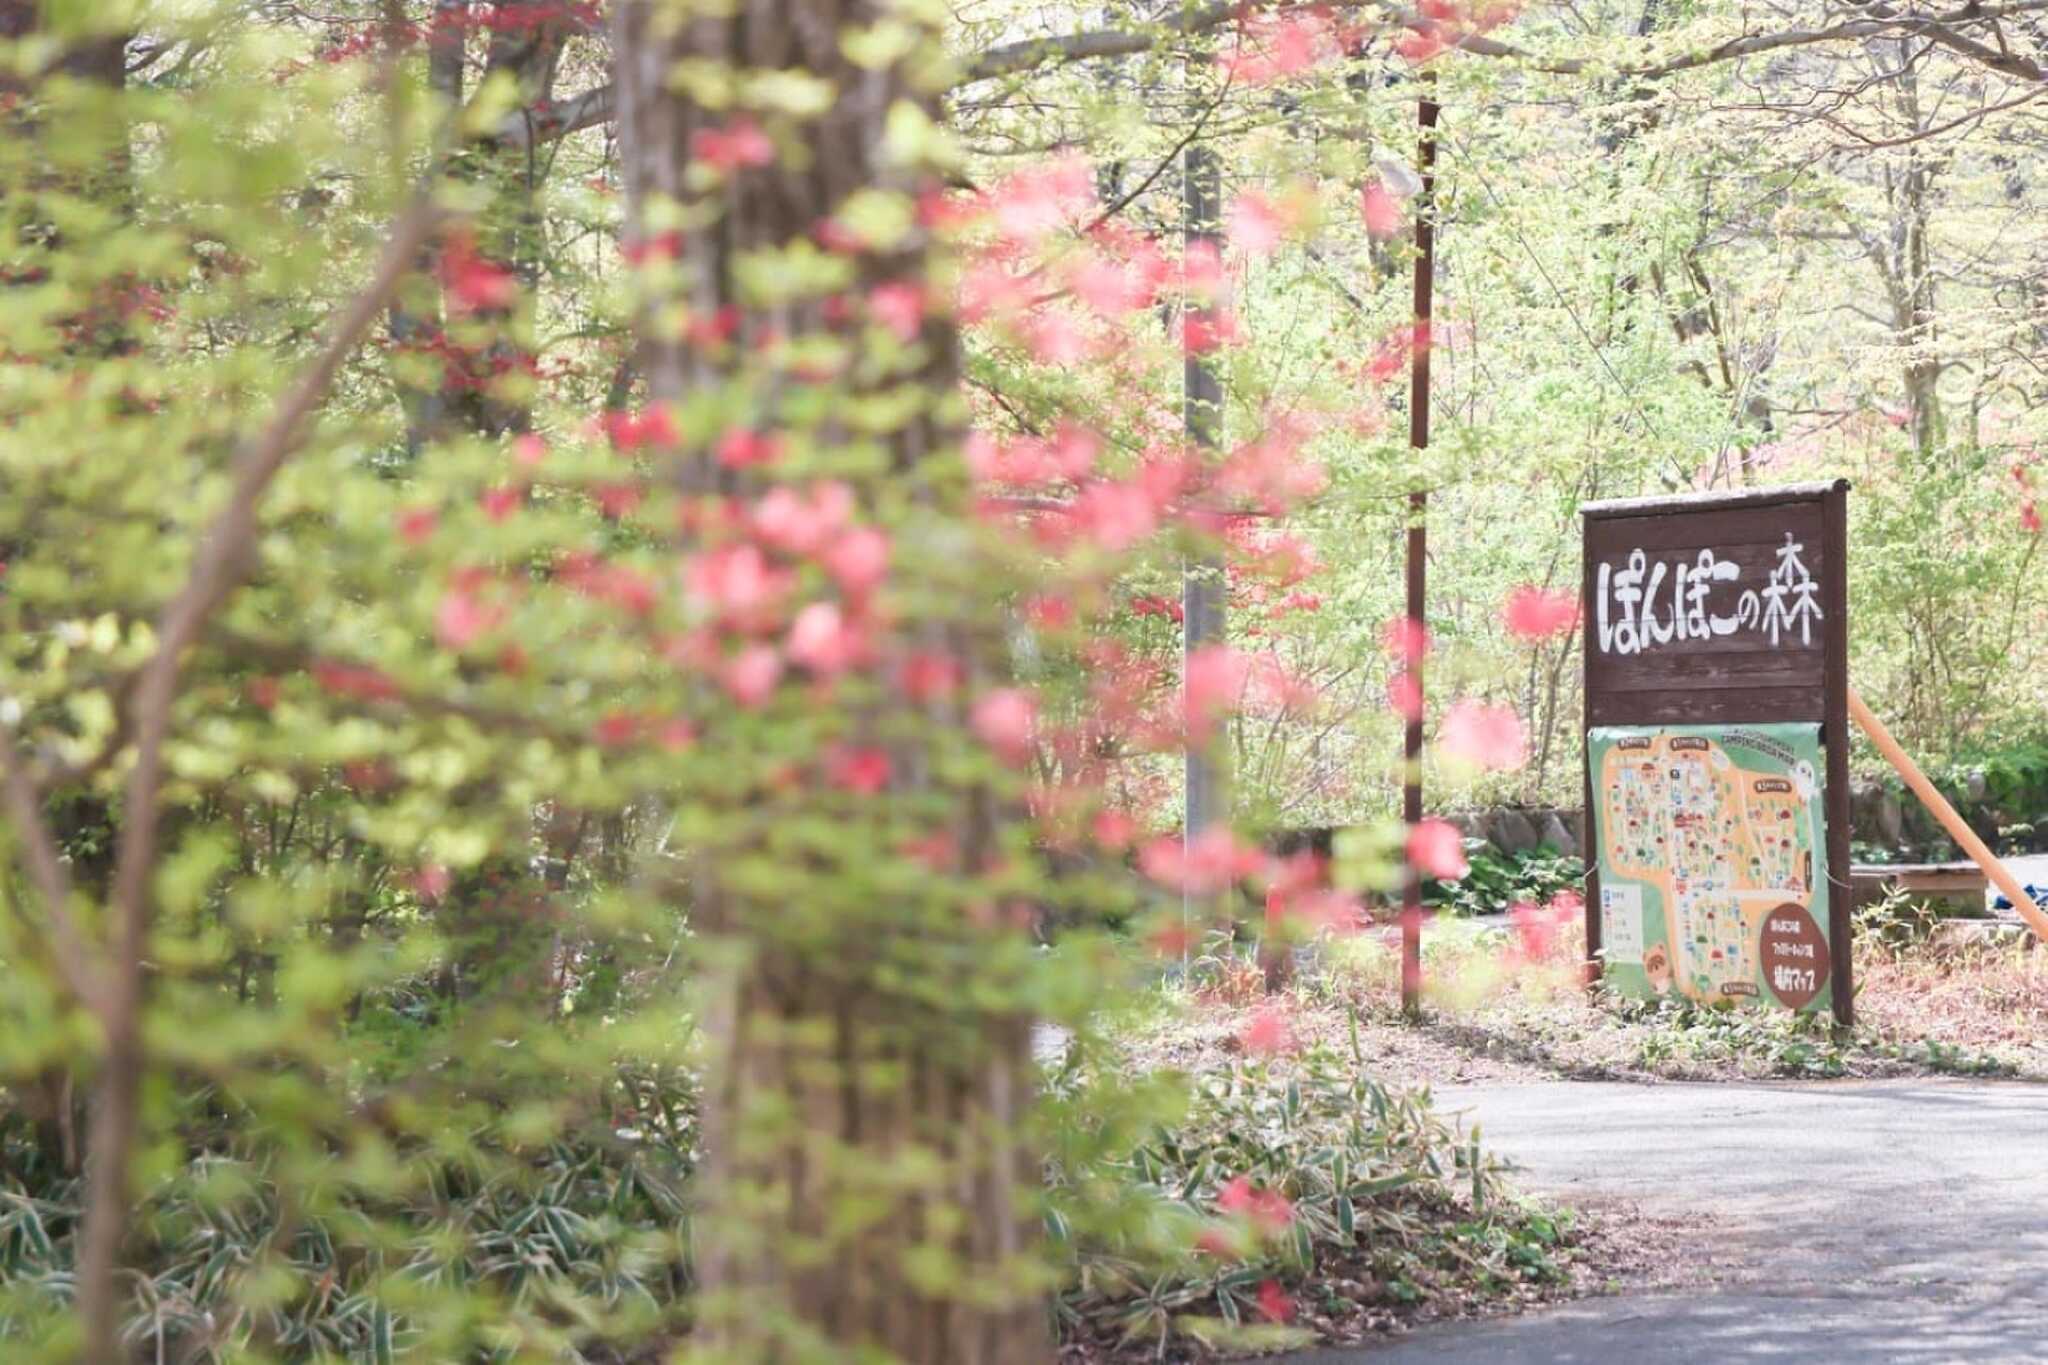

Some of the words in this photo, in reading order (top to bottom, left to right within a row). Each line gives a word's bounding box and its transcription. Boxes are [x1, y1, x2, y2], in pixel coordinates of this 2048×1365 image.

[1597, 532, 1823, 654] ぽんぽこの森
